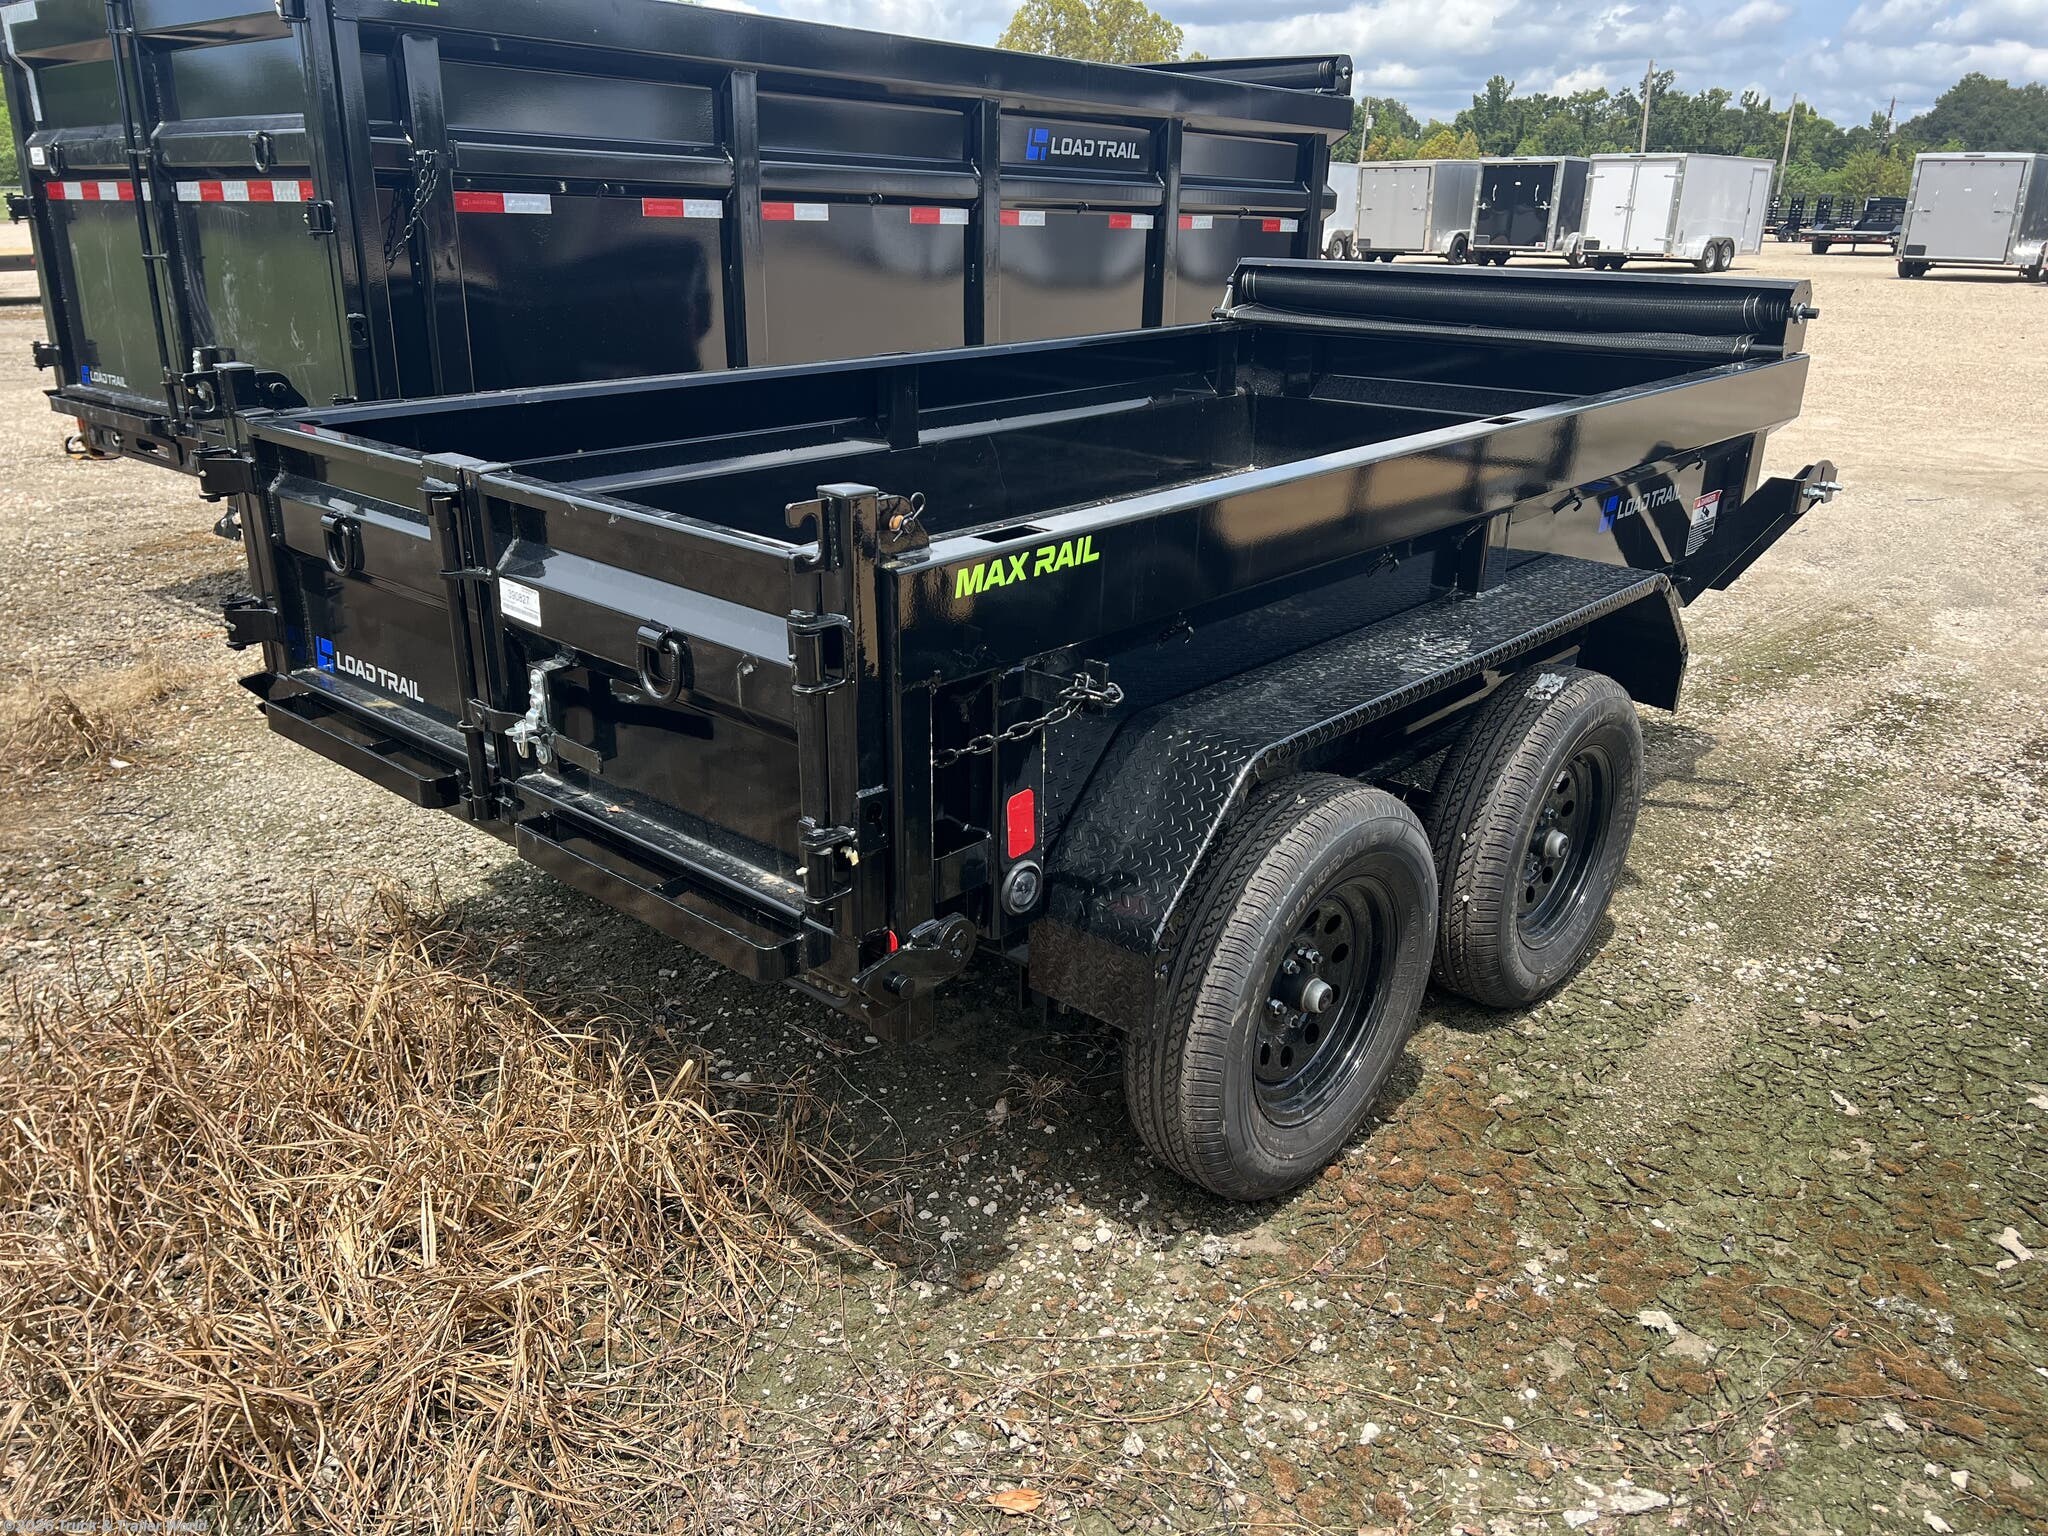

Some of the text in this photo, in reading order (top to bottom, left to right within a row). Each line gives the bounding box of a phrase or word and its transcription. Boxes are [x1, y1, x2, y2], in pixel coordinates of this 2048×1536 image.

[1050, 137, 1140, 159] LOAD TRAIL
[1617, 484, 1682, 520] LOAD TRAIL
[955, 535, 1100, 599] MAX RAIL
[336, 651, 424, 703] LOAD TRAIL
